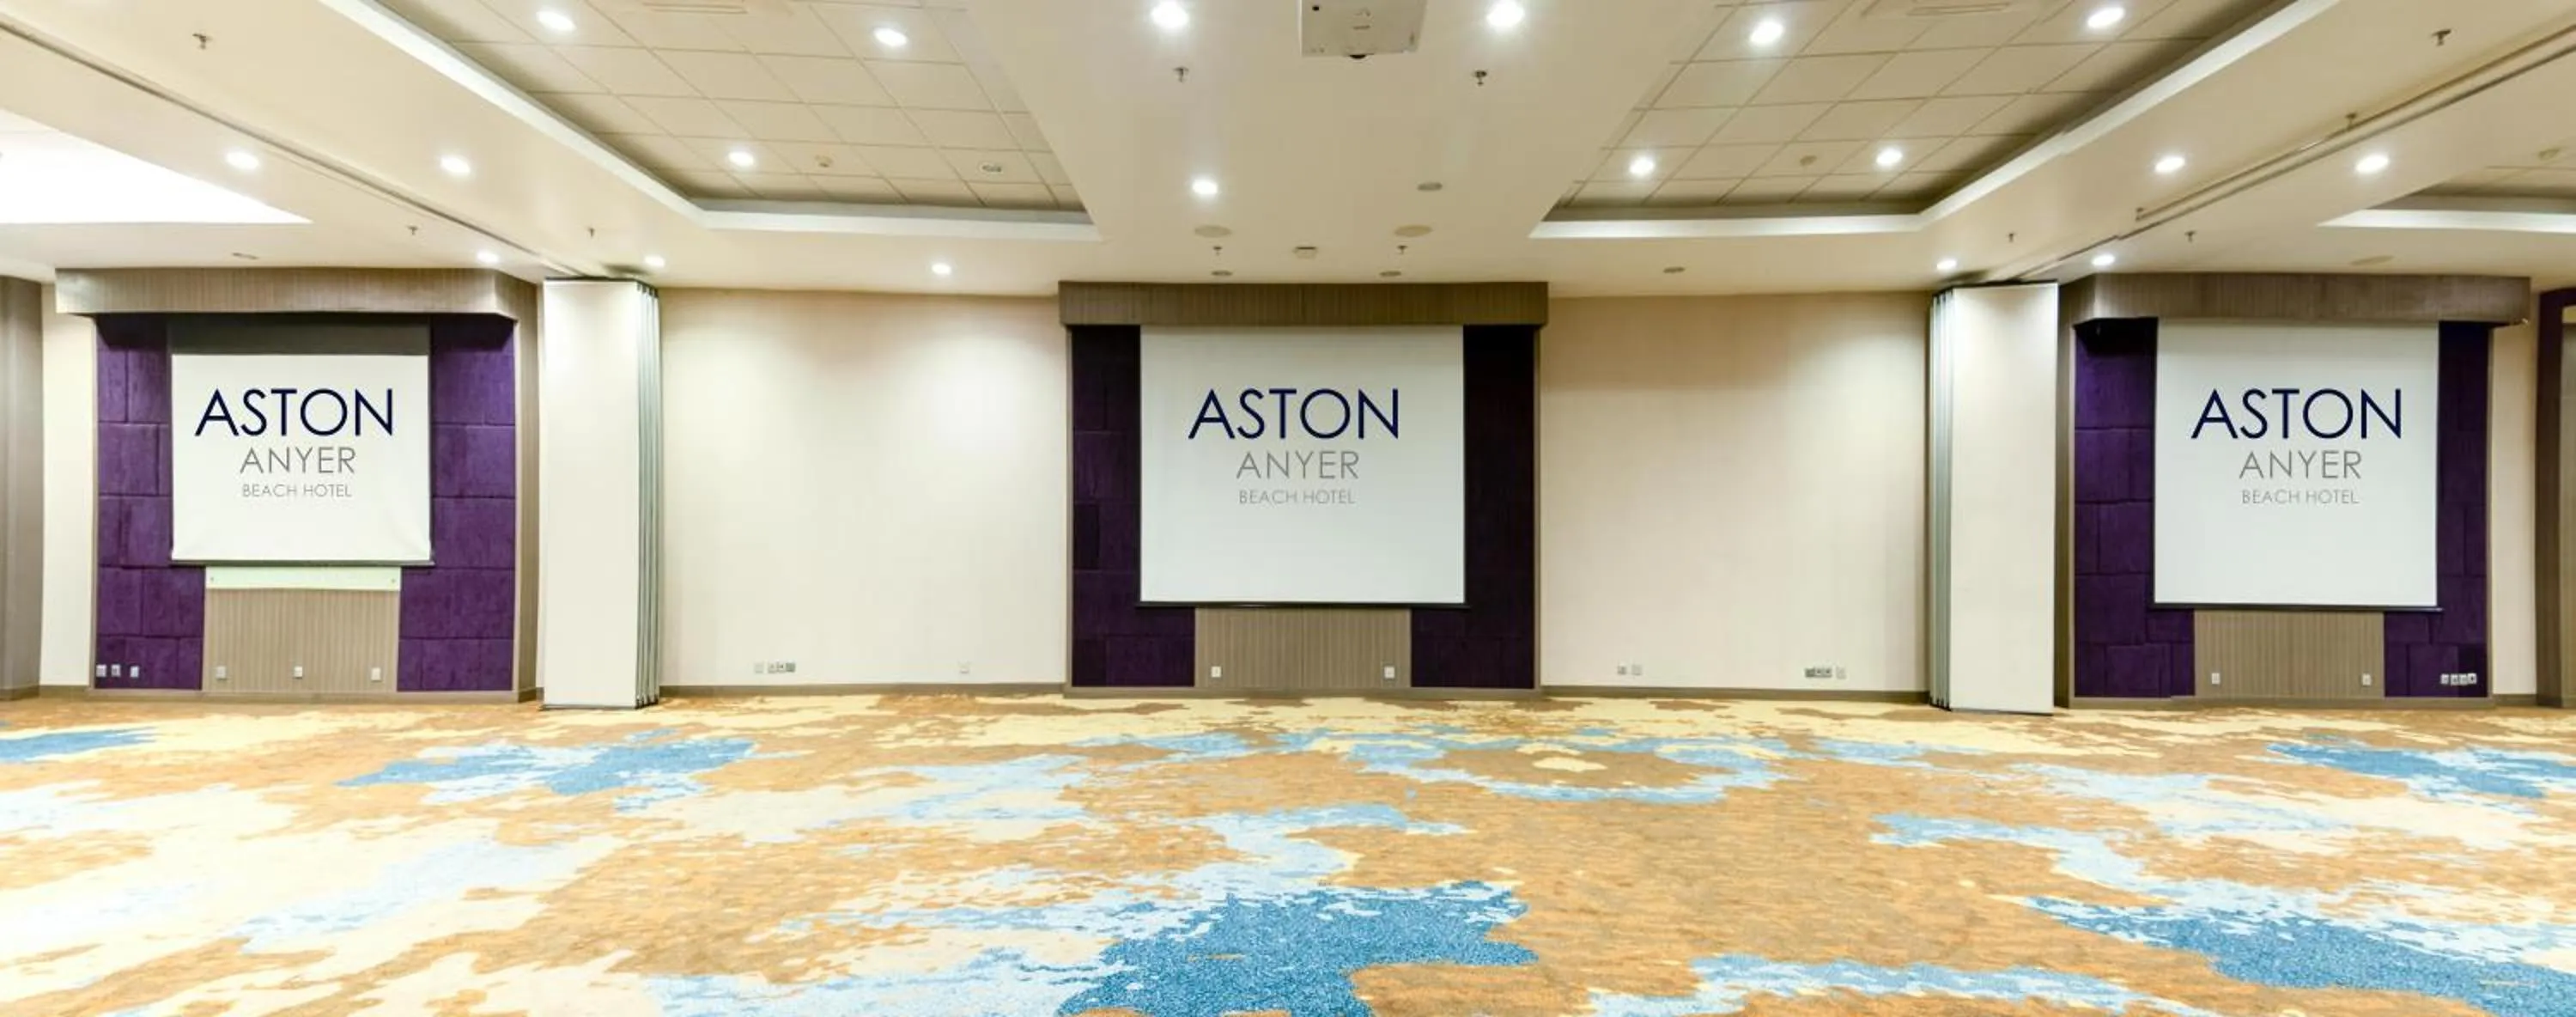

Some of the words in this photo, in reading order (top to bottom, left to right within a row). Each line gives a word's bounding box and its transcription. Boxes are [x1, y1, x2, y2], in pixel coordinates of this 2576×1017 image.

[194, 388, 393, 436] ASTON
[1188, 388, 1399, 439] ASTON
[2190, 388, 2402, 439] ASTON
[240, 447, 356, 473] ANYER
[1236, 450, 1359, 478] ANYER
[2239, 450, 2361, 478] ANYER
[242, 484, 297, 497] BEACH
[303, 484, 351, 497] HOTEL
[1239, 489, 1297, 504] BEACH
[1303, 489, 1355, 504] HOTEL
[2242, 489, 2300, 504] BEACH
[2306, 489, 2360, 504] HOTEL
